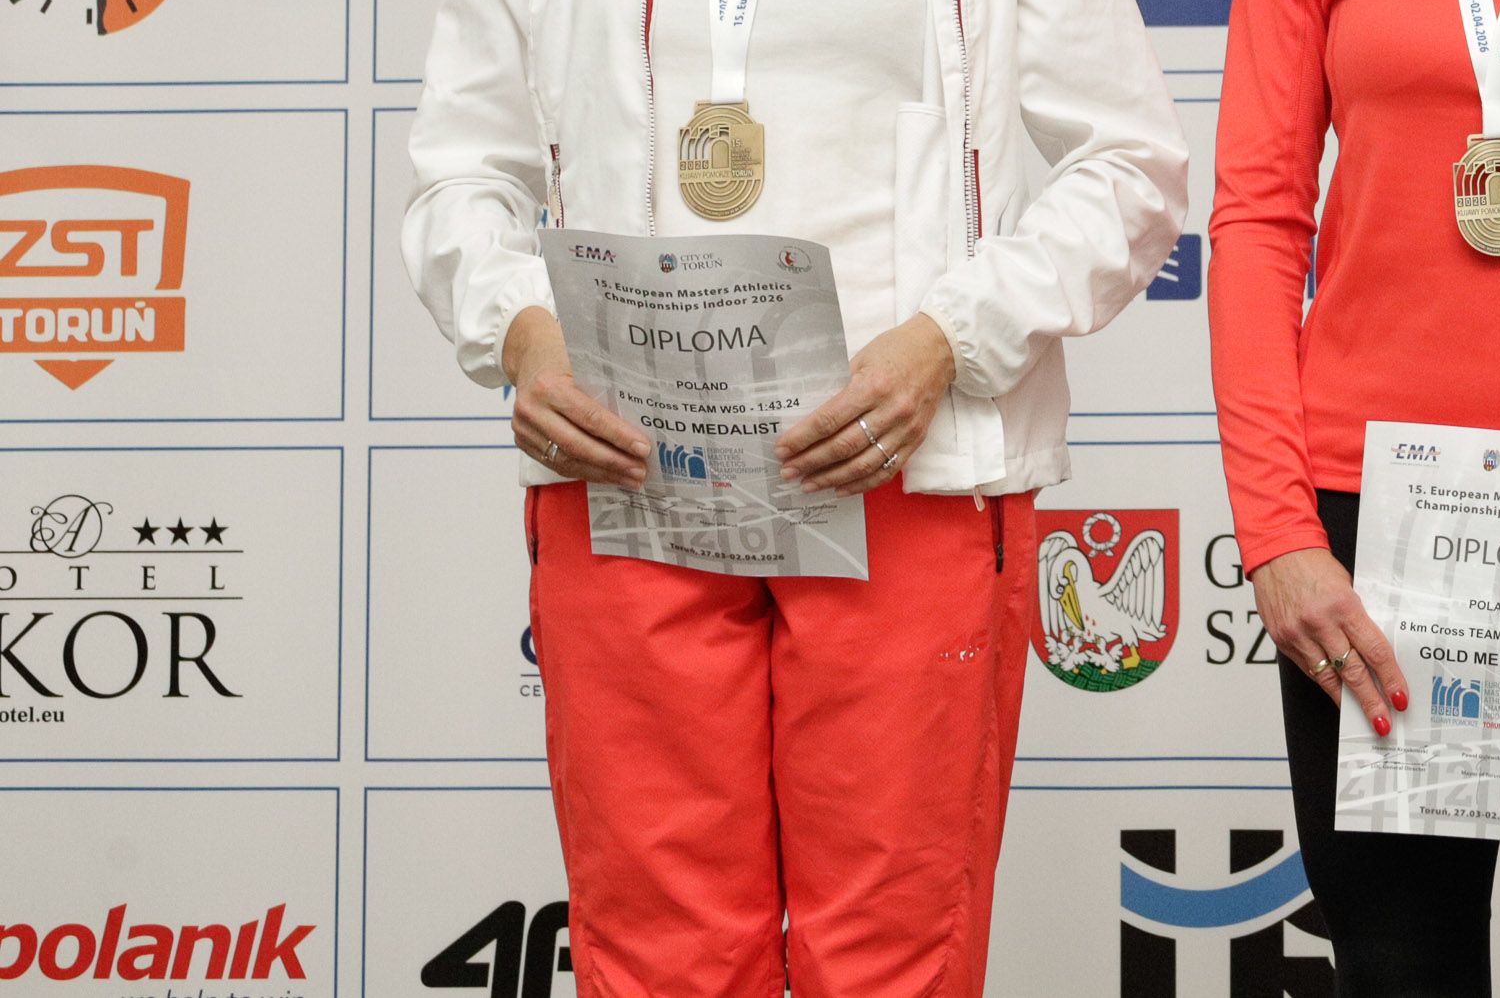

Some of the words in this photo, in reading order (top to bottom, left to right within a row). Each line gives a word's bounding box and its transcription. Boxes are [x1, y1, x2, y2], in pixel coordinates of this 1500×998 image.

[574, 245, 616, 264] EMA
[594, 278, 613, 290] 15.
[615, 282, 673, 299] European
[677, 285, 729, 299] Masters
[733, 281, 792, 293] Athletics
[604, 291, 700, 313] Championships
[703, 296, 748, 310] Indoor
[751, 292, 784, 305] 2026
[0, 301, 156, 342] TORUŃ
[628, 323, 768, 353] DIPLOMA
[676, 380, 729, 392] POLAND
[619, 390, 626, 399] 8
[627, 393, 643, 405] km
[646, 398, 679, 411] Cross
[683, 403, 717, 414] TEAM
[720, 404, 746, 414] W50
[757, 398, 800, 412] 1:43.24
[640, 415, 687, 433] GOLD
[692, 421, 781, 436] MEDALIST
[1396, 444, 1437, 462] EMA
[1408, 484, 1427, 495] 15.
[1430, 486, 1490, 501] European
[1400, 620, 1407, 631] 8
[1410, 621, 1427, 633] km
[1431, 624, 1465, 637] Cross
[1419, 646, 1468, 663] GOLD
[1419, 805, 1451, 817] Toruń,
